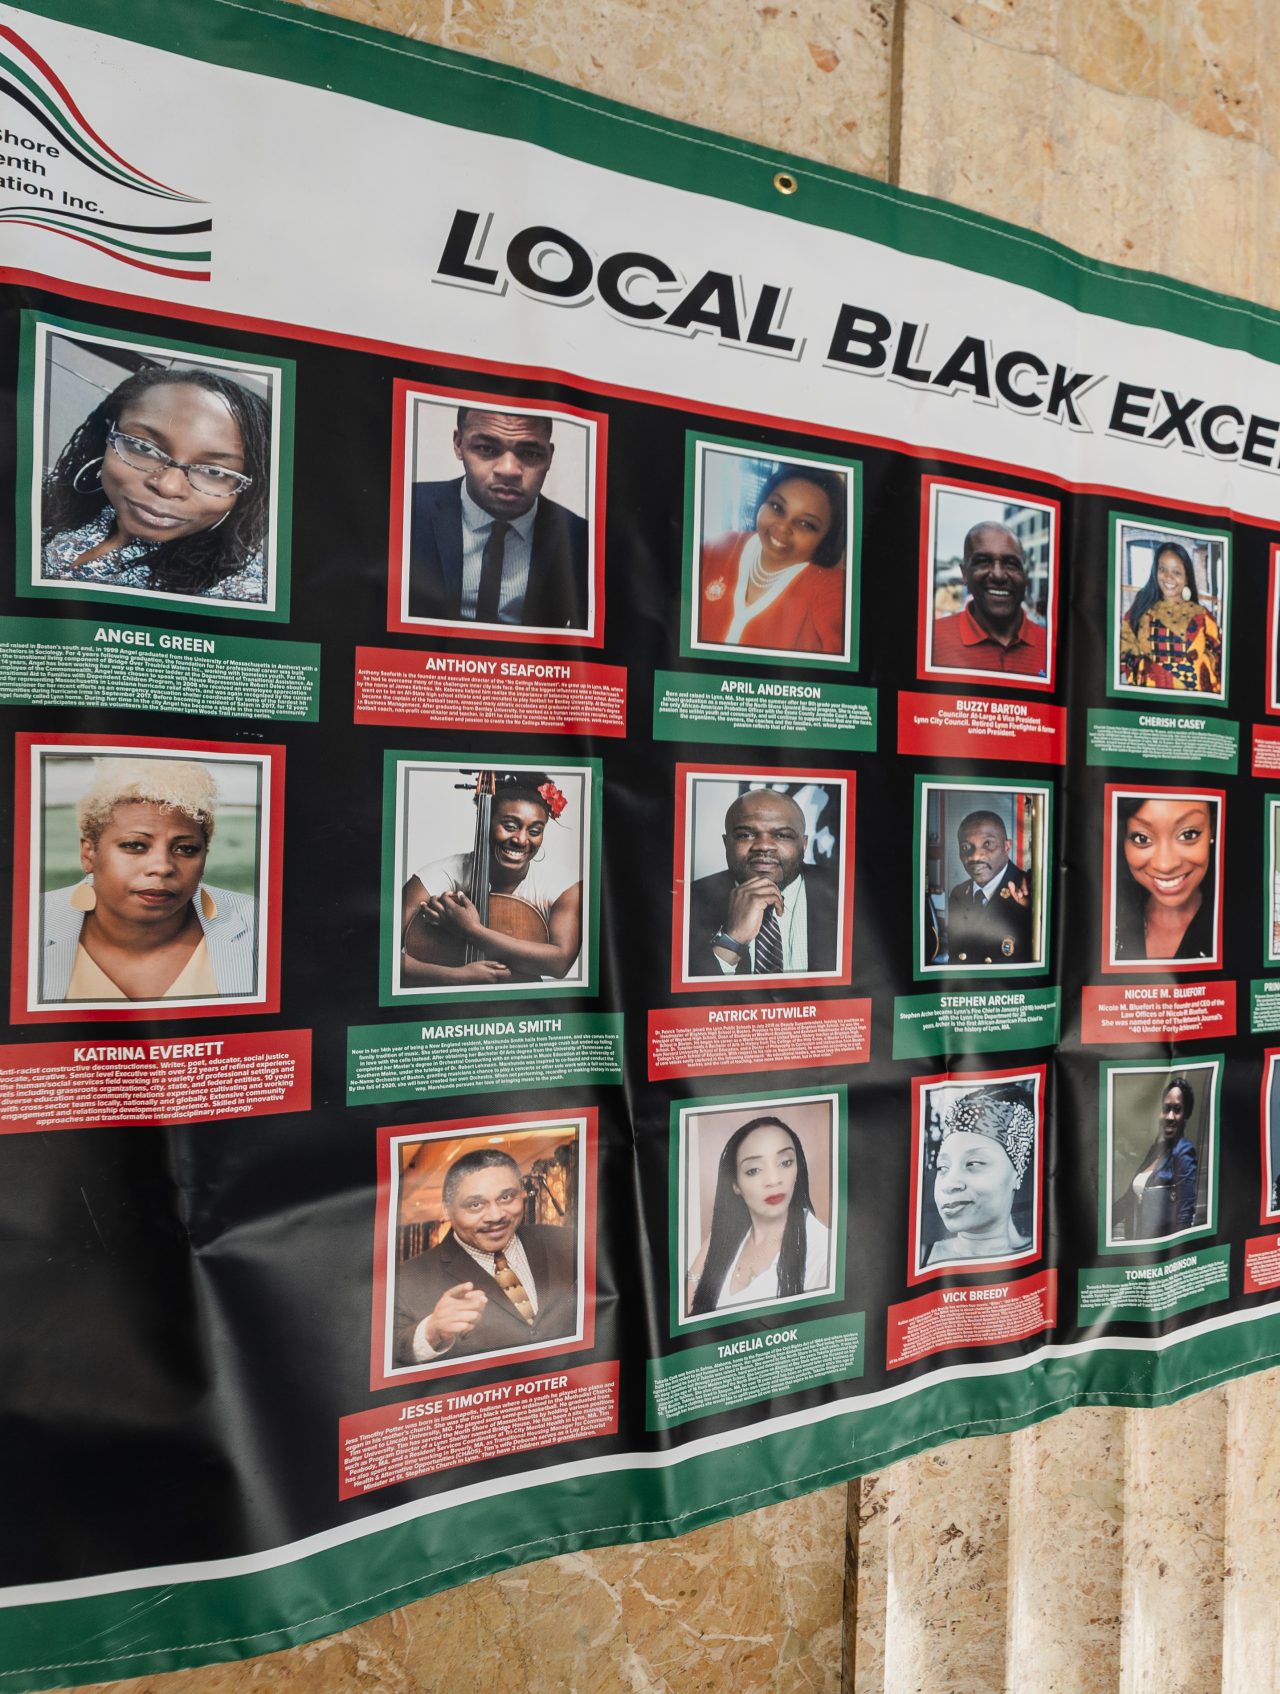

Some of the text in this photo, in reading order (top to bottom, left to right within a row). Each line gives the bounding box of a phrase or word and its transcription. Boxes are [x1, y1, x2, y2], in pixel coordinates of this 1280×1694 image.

[0, 129, 60, 158] hore
[62, 191, 104, 214] Inc.
[434, 209, 802, 356] LOCAL
[824, 302, 1098, 428] BLACK
[94, 628, 215, 653] ANGEL GREEN
[425, 657, 571, 679] ANTHONY SEAFORTH
[720, 680, 821, 699] APRIL ANDERSON
[956, 700, 1027, 716] BUZZY BARTON
[1139, 716, 1206, 730] CHERISH CASEY
[940, 994, 1025, 1008] STEPHEN ARCHER
[1125, 986, 1206, 1000] NICOLE M. BLUEFORT
[708, 1005, 817, 1023] PATRICK TUTWILER
[421, 1019, 562, 1040] MARSHUNDA SMITH
[73, 1041, 224, 1062] KATRINA EVERETT
[160, 1061, 186, 1069] Writer,
[188, 1059, 207, 1068] poet,
[209, 1056, 242, 1065] educator,
[265, 1053, 289, 1061] justice
[32, 1073, 67, 1081] curative.
[199, 1066, 219, 1074] years
[229, 1062, 255, 1070] refined
[122, 1077, 151, 1085] working
[168, 1075, 195, 1084] variety
[251, 1067, 279, 1076] settings
[16, 1088, 55, 1098] including
[150, 1084, 166, 1092] city,
[168, 1082, 190, 1090] state,
[207, 1078, 232, 1086] federal
[234, 1075, 263, 1083] entities.
[33, 1094, 75, 1103] education
[92, 1093, 132, 1101] community
[264, 1080, 293, 1089] working
[97, 1100, 122, 1108] locally,
[176, 1095, 208, 1104] globally.
[210, 1091, 245, 1100] Extensive
[245, 1087, 285, 1098] community
[212, 1099, 237, 1107] Skilled
[216, 1104, 253, 1115] pedagogy.
[1125, 1255, 1197, 1281] TOMEKA ROBINSON
[943, 1287, 1009, 1303] VICK BREEDY
[717, 1328, 798, 1358] TAKELIA COOK
[398, 1375, 568, 1421] JESSE TIMOTHY POTTER
